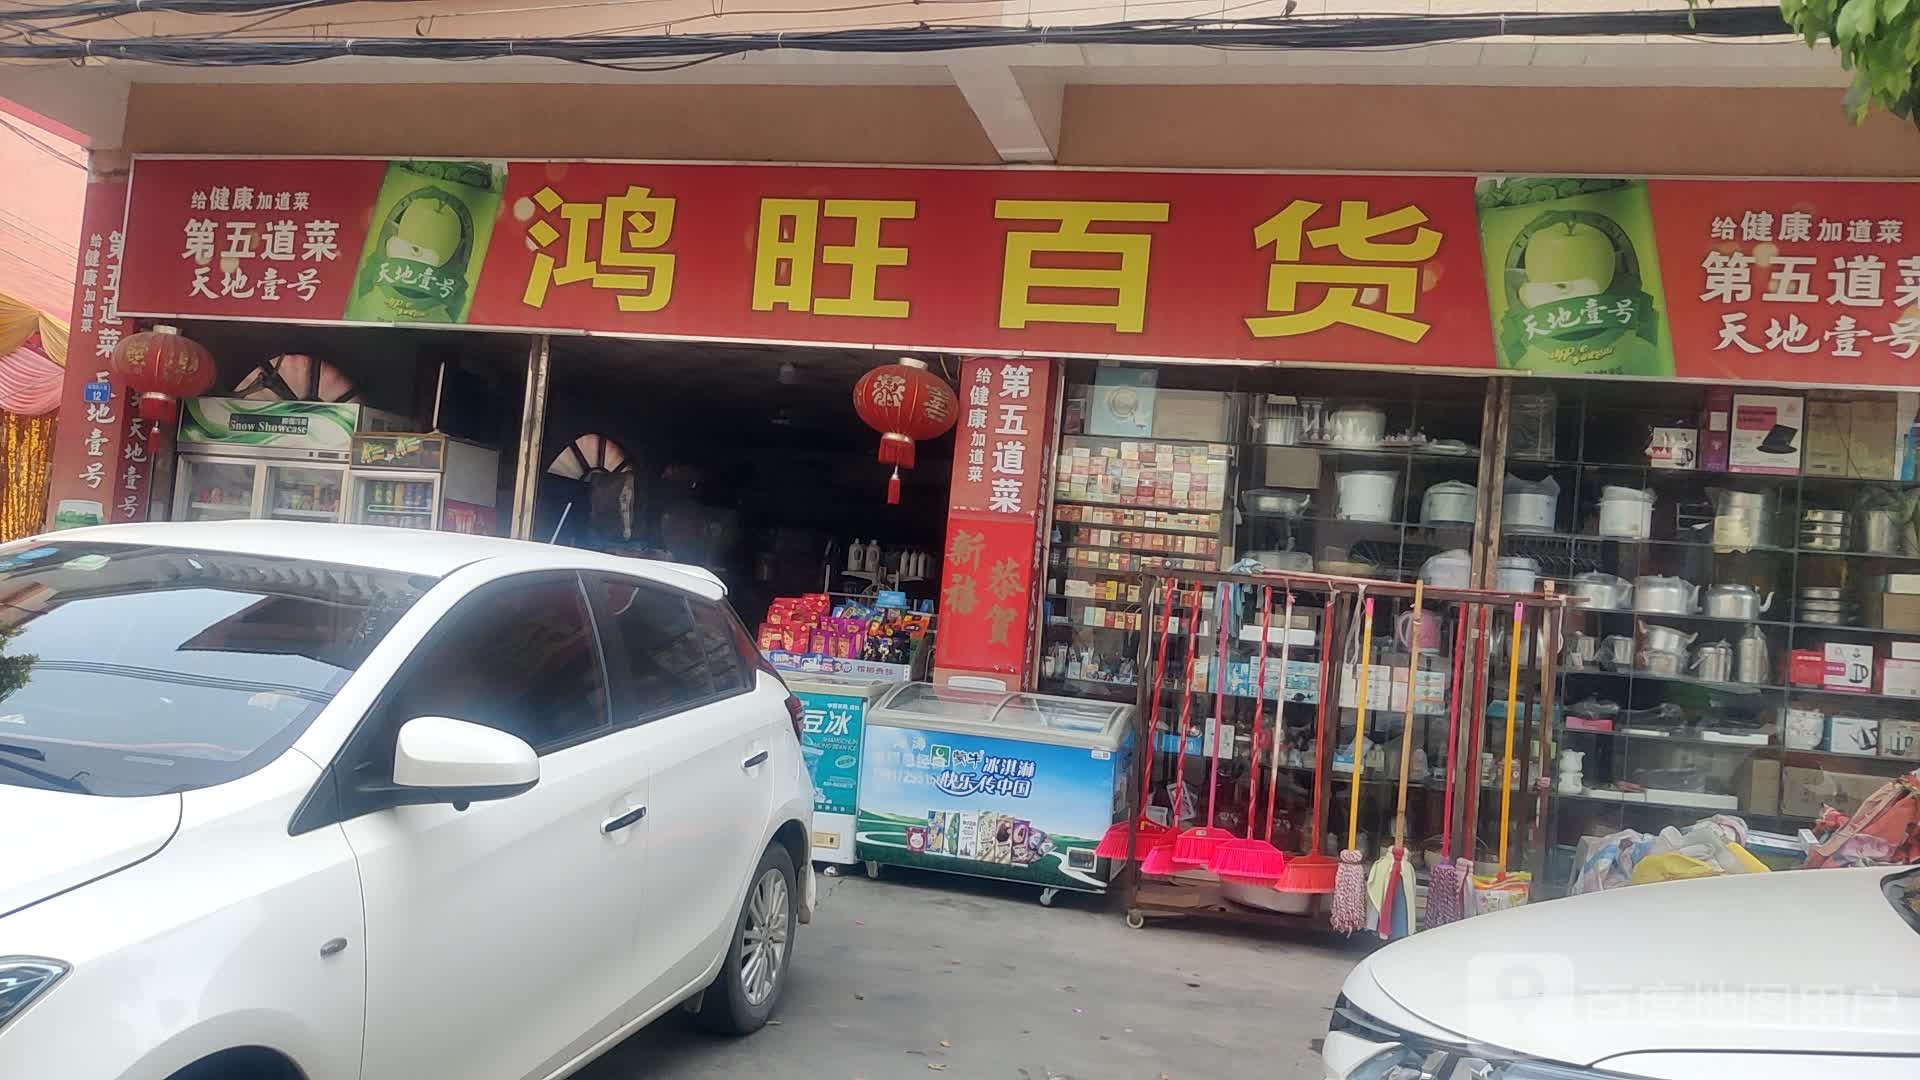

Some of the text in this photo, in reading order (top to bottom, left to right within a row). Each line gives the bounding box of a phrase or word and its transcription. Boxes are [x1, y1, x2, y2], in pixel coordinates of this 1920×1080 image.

[191, 186, 310, 211] 给健康加道菜
[181, 218, 340, 262] 第五道菜
[1711, 211, 1904, 244] 给健康加道菜
[377, 262, 456, 298] 天地壹号
[522, 185, 1442, 343] 鸿旺百货
[80, 233, 103, 333] 给健康加道菜
[189, 266, 321, 301] 天地壹号
[1523, 297, 1635, 341] 天地壹号
[92, 391, 102, 401] 12
[230, 419, 256, 432] Snow
[257, 421, 308, 434] Showcase
[967, 367, 992, 482] 给健康加道菜
[989, 364, 1033, 513] 第五道菜
[118, 417, 148, 518] 天地壹号
[952, 749, 983, 769] 蒙牛
[938, 770, 1032, 798] 快乐传中国
